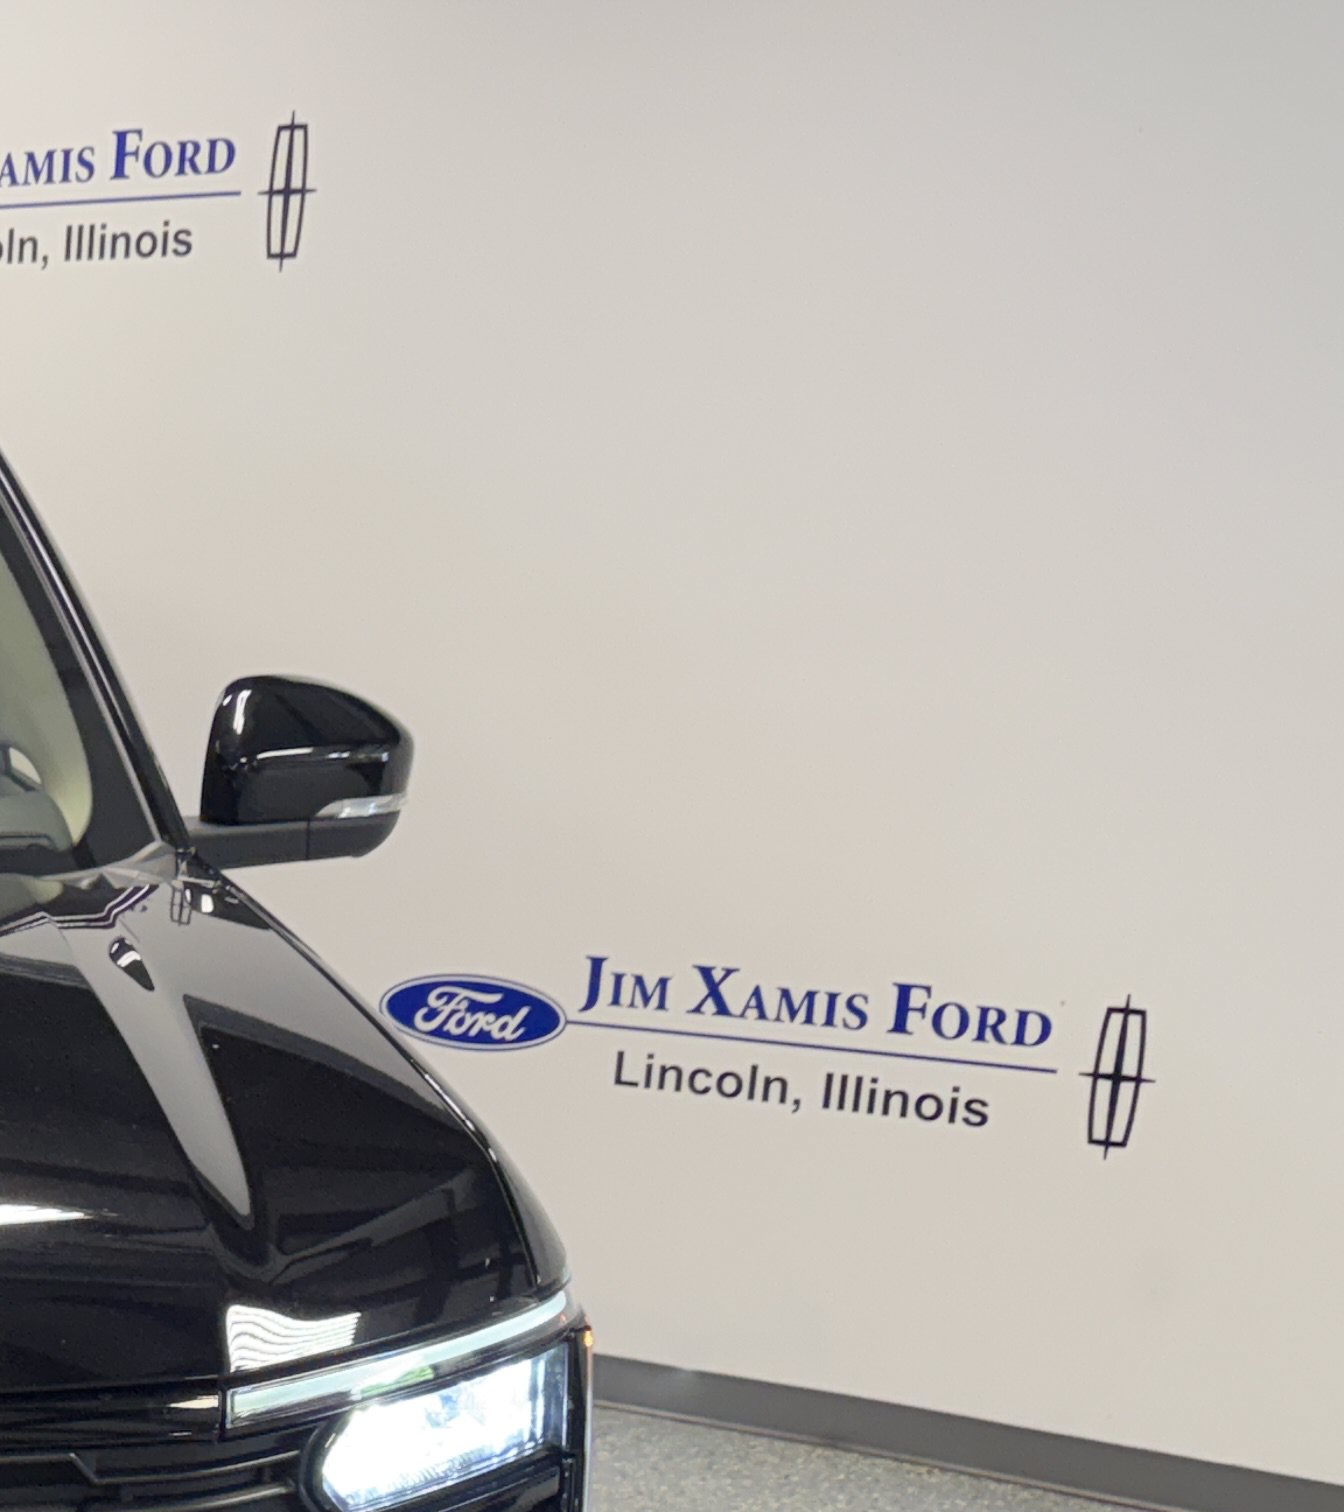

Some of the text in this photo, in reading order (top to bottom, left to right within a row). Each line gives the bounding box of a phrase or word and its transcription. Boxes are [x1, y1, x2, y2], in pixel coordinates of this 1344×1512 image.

[109, 129, 235, 180] FORD
[64, 221, 193, 261] Illinois
[413, 986, 526, 1042] Ford
[578, 955, 1052, 1048] JIM XAMIS FORD
[614, 1050, 990, 1128] Lincoln, Illinois
